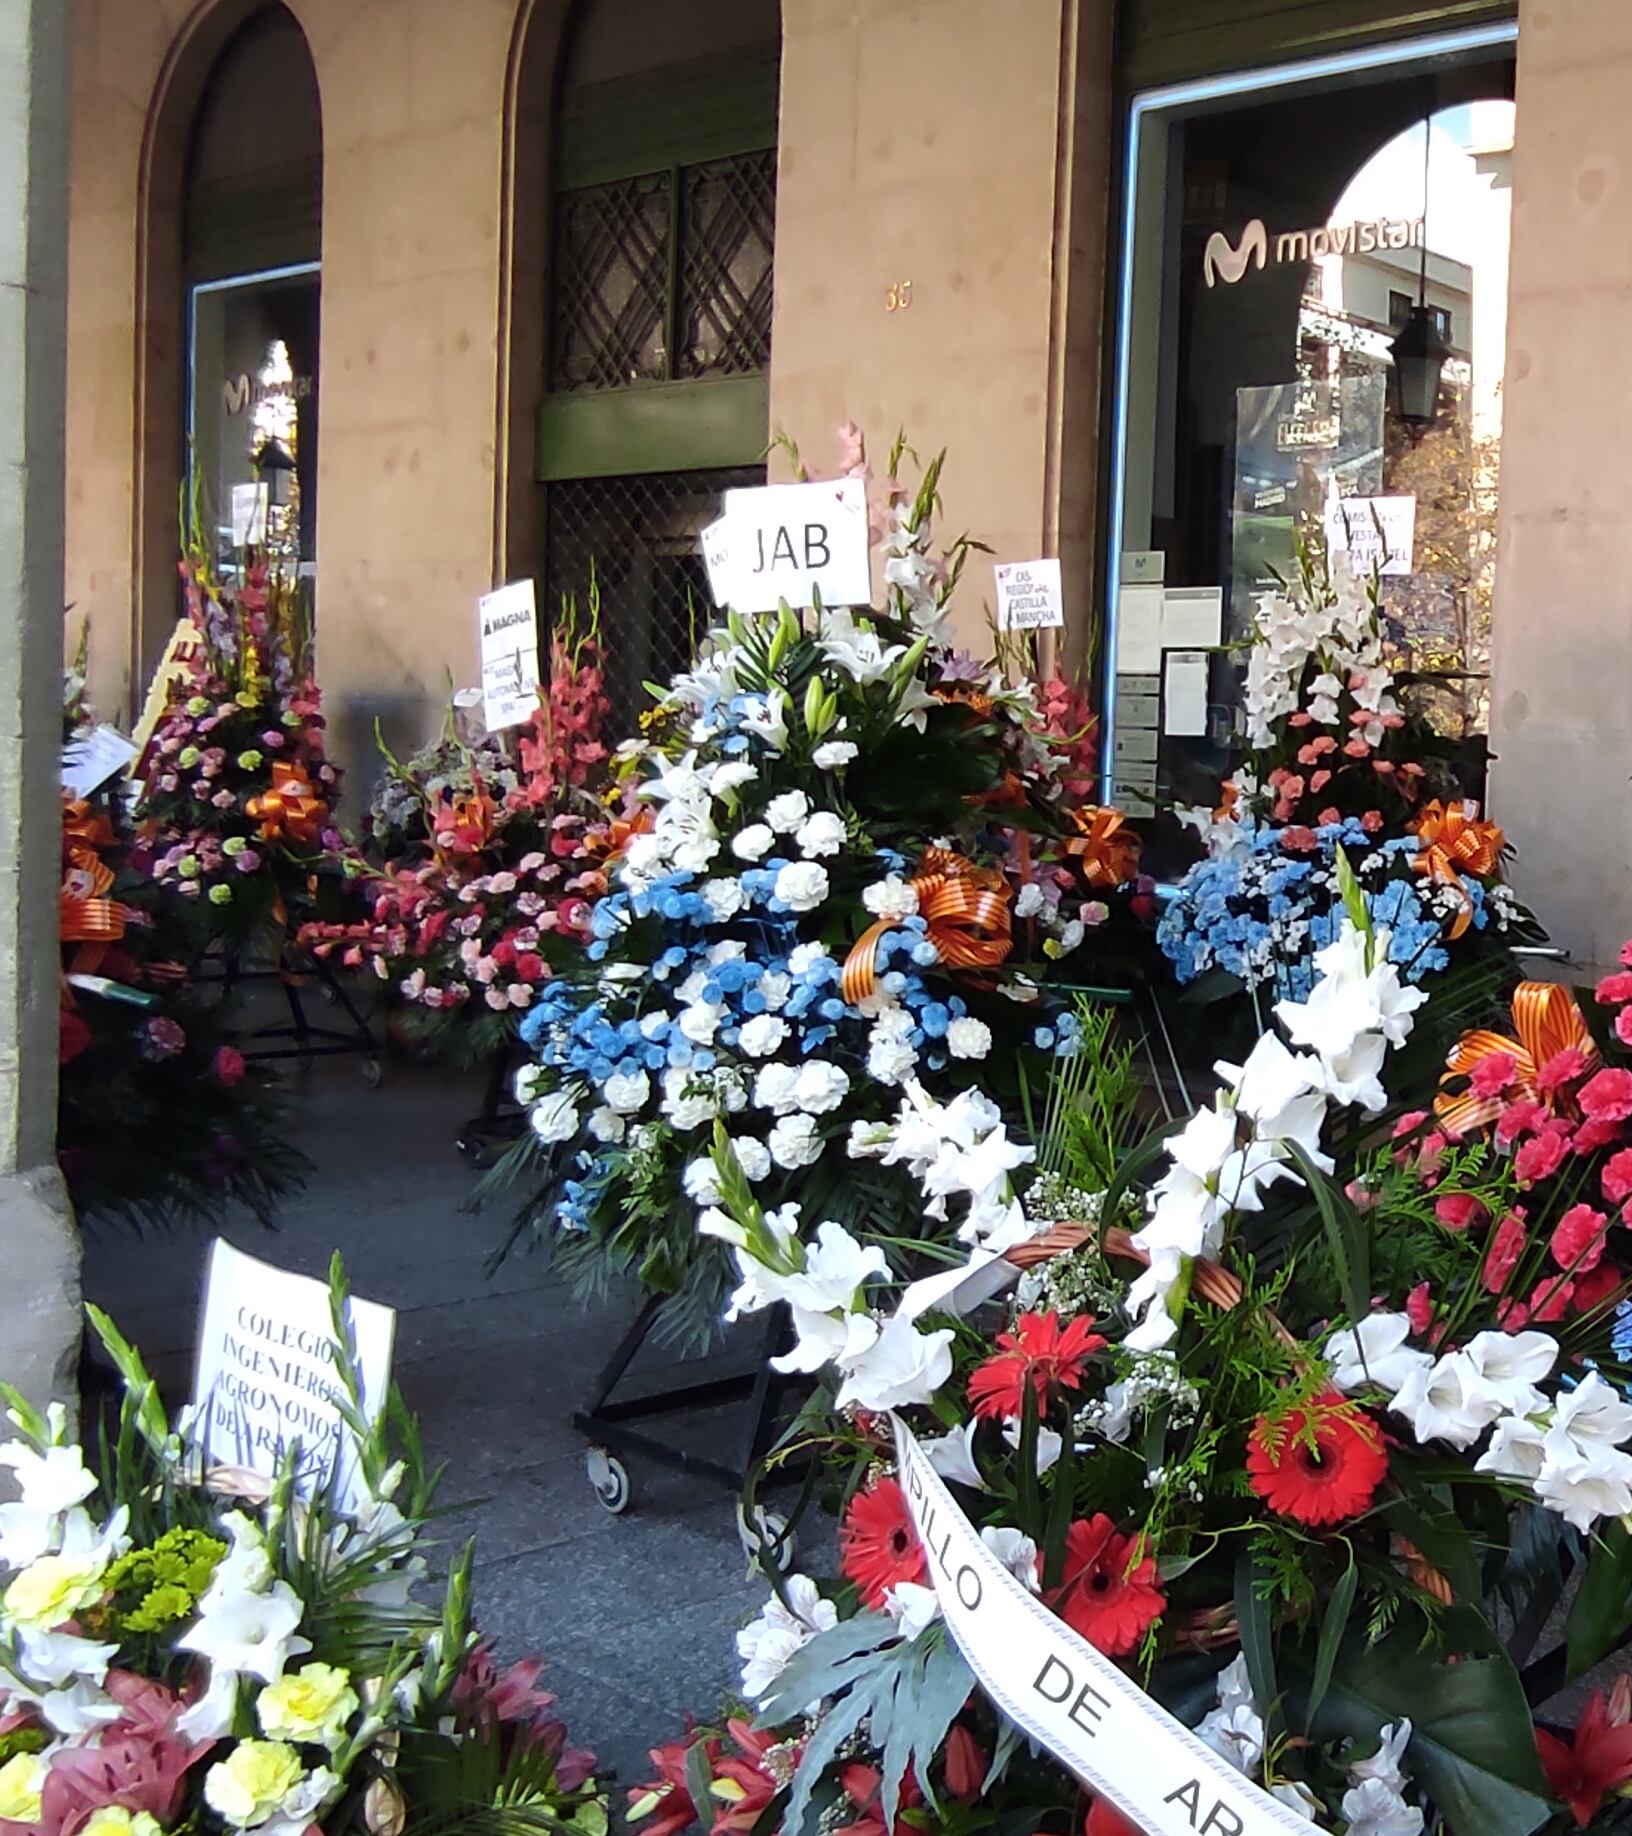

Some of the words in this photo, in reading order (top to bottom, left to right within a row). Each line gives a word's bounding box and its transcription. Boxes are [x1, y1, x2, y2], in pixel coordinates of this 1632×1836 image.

[1276, 217, 1424, 263] movistar
[885, 280, 912, 311] 35
[752, 522, 832, 574] JAB
[493, 610, 531, 633] MAGNA
[237, 1306, 334, 1364] COLEGIO
[1032, 1653, 1112, 1738] DE
